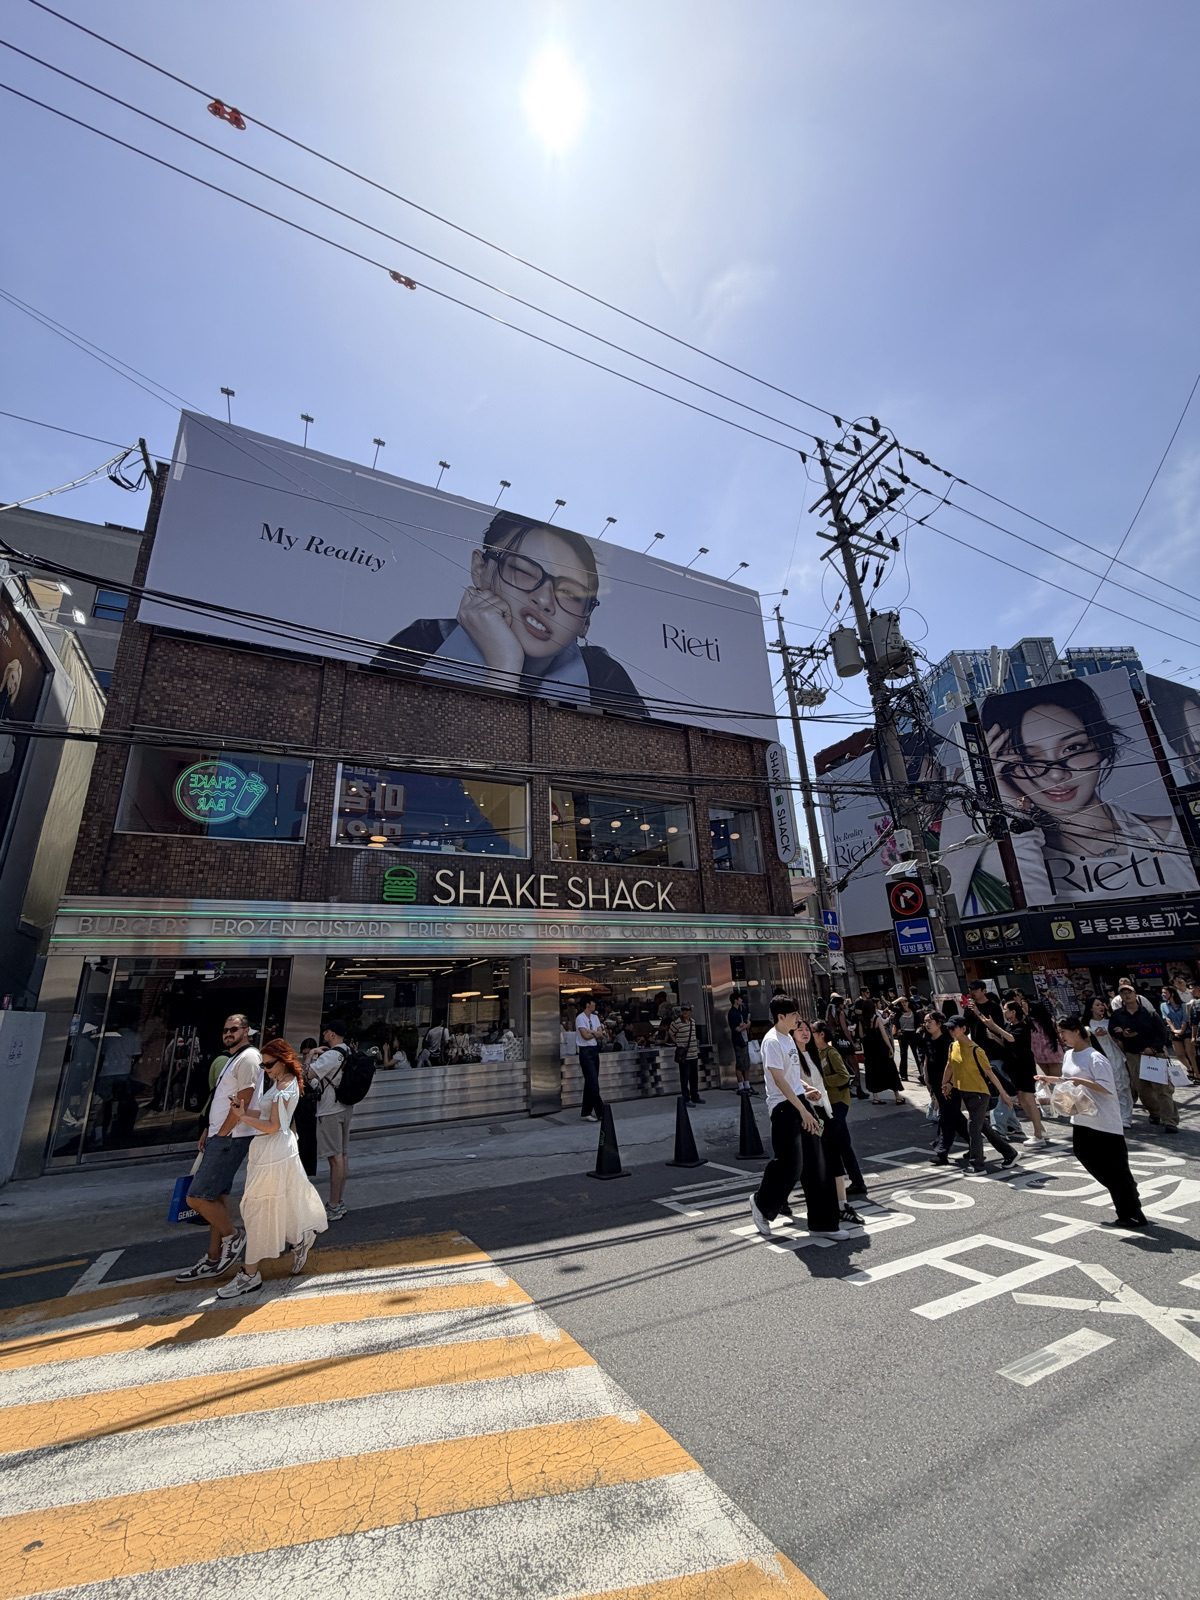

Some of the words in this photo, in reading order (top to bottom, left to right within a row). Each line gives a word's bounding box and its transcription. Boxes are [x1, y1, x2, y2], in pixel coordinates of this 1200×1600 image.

[258, 522, 299, 552] My
[303, 535, 386, 573] Reality
[662, 623, 720, 663] Rieti
[777, 808, 792, 855] SHACK
[433, 869, 560, 908] SHAKE
[567, 876, 677, 911] SHACK
[1043, 851, 1166, 896] Rieti
[77, 916, 191, 934] BURGERS
[211, 919, 296, 936] FROZEN
[304, 920, 392, 937] CUSTARD
[408, 922, 453, 937] FRIES
[466, 923, 526, 938] SHAKES
[621, 926, 697, 939] CONCRETES
[706, 928, 749, 940] FLOATS
[1079, 911, 1200, 934] 길동우동&돈까스
[901, 942, 932, 954] 일방통행
